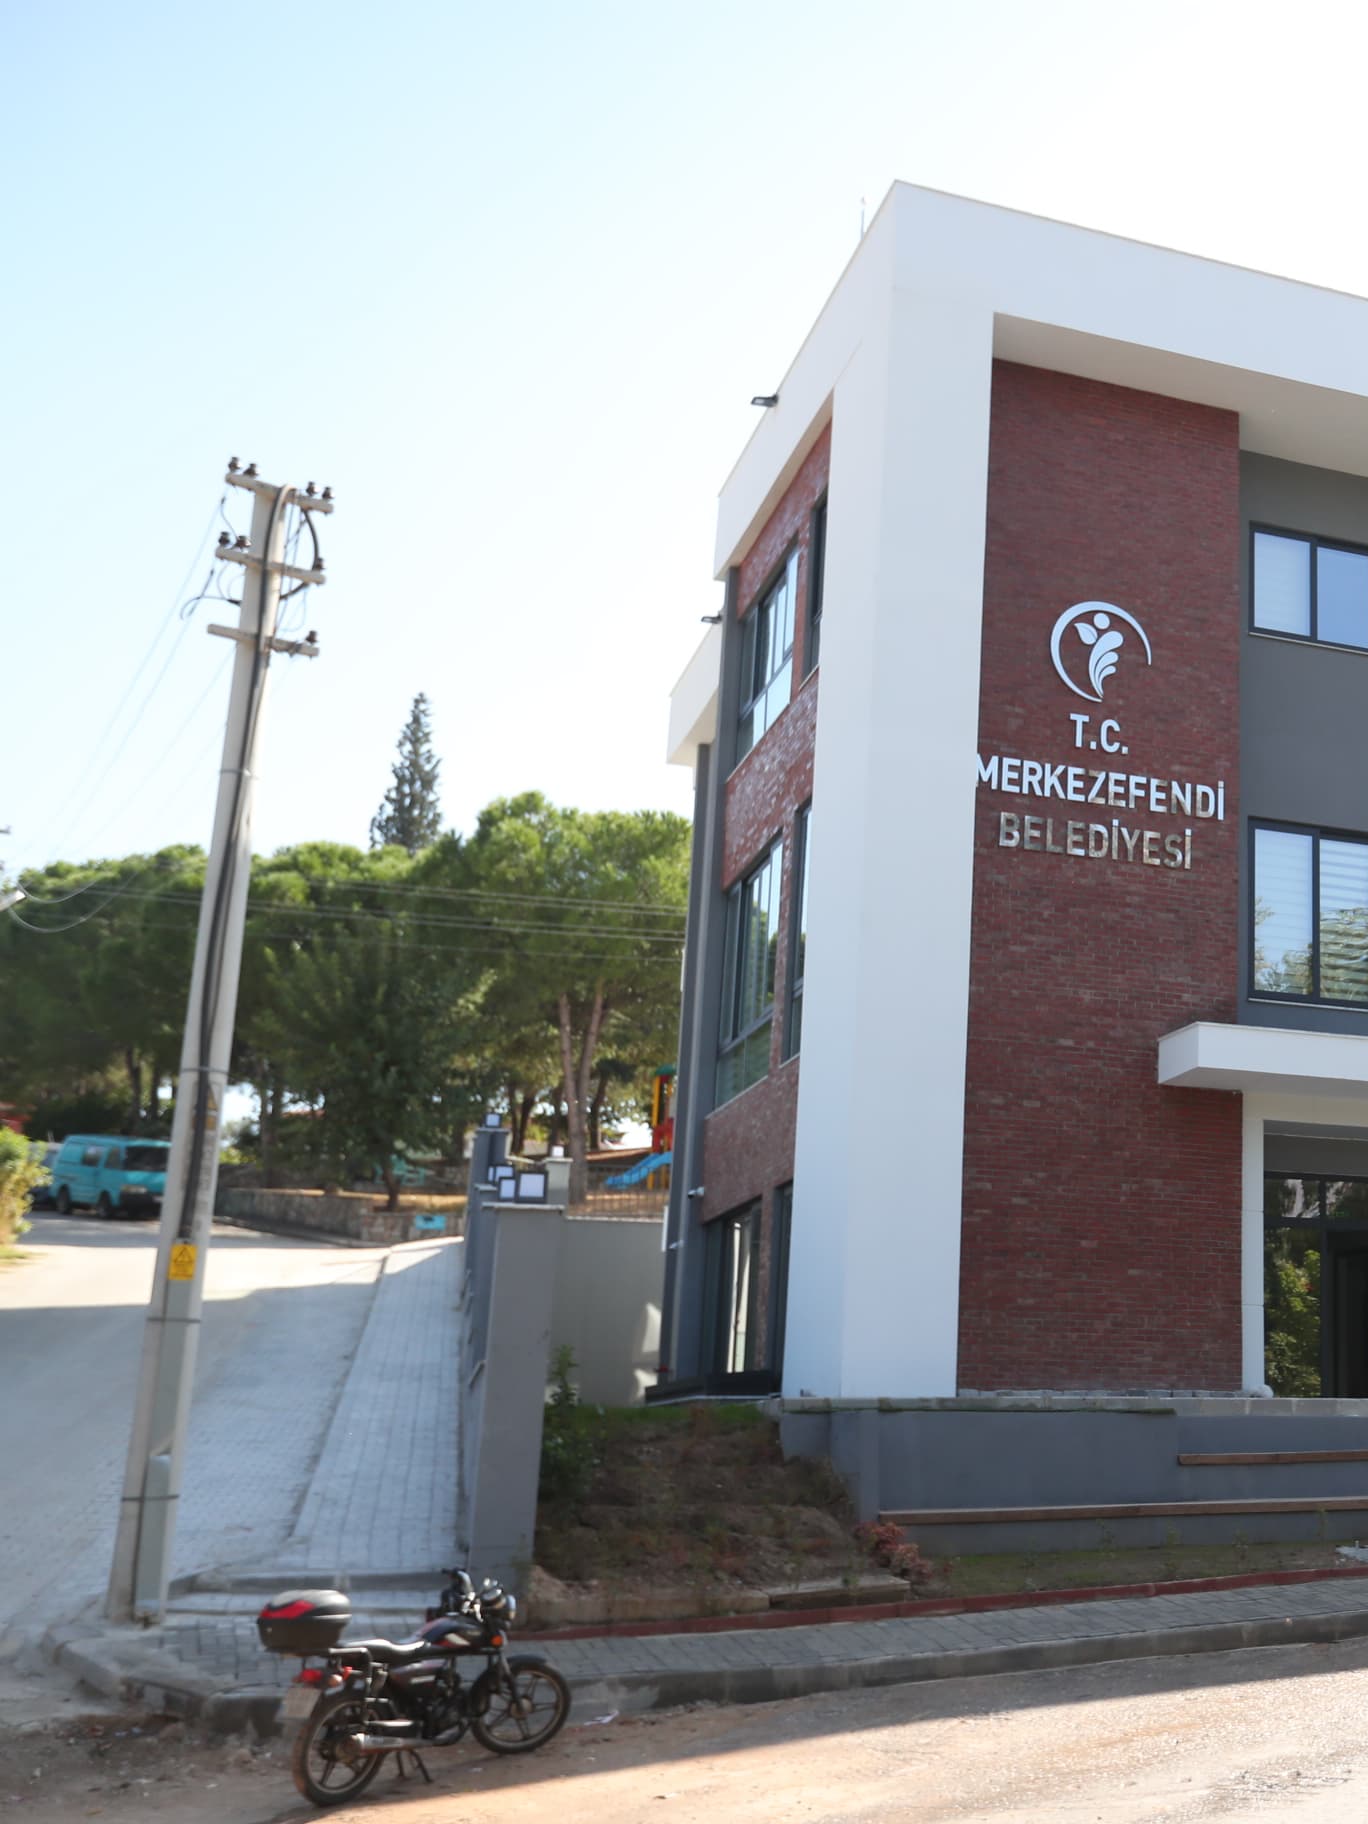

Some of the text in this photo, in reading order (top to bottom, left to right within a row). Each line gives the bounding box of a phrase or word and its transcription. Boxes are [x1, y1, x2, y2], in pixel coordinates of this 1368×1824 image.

[1070, 713, 1129, 754] T.C.
[976, 753, 1225, 821] MERKEZEFENDİ
[999, 812, 1192, 870] BELEDİYESİ
